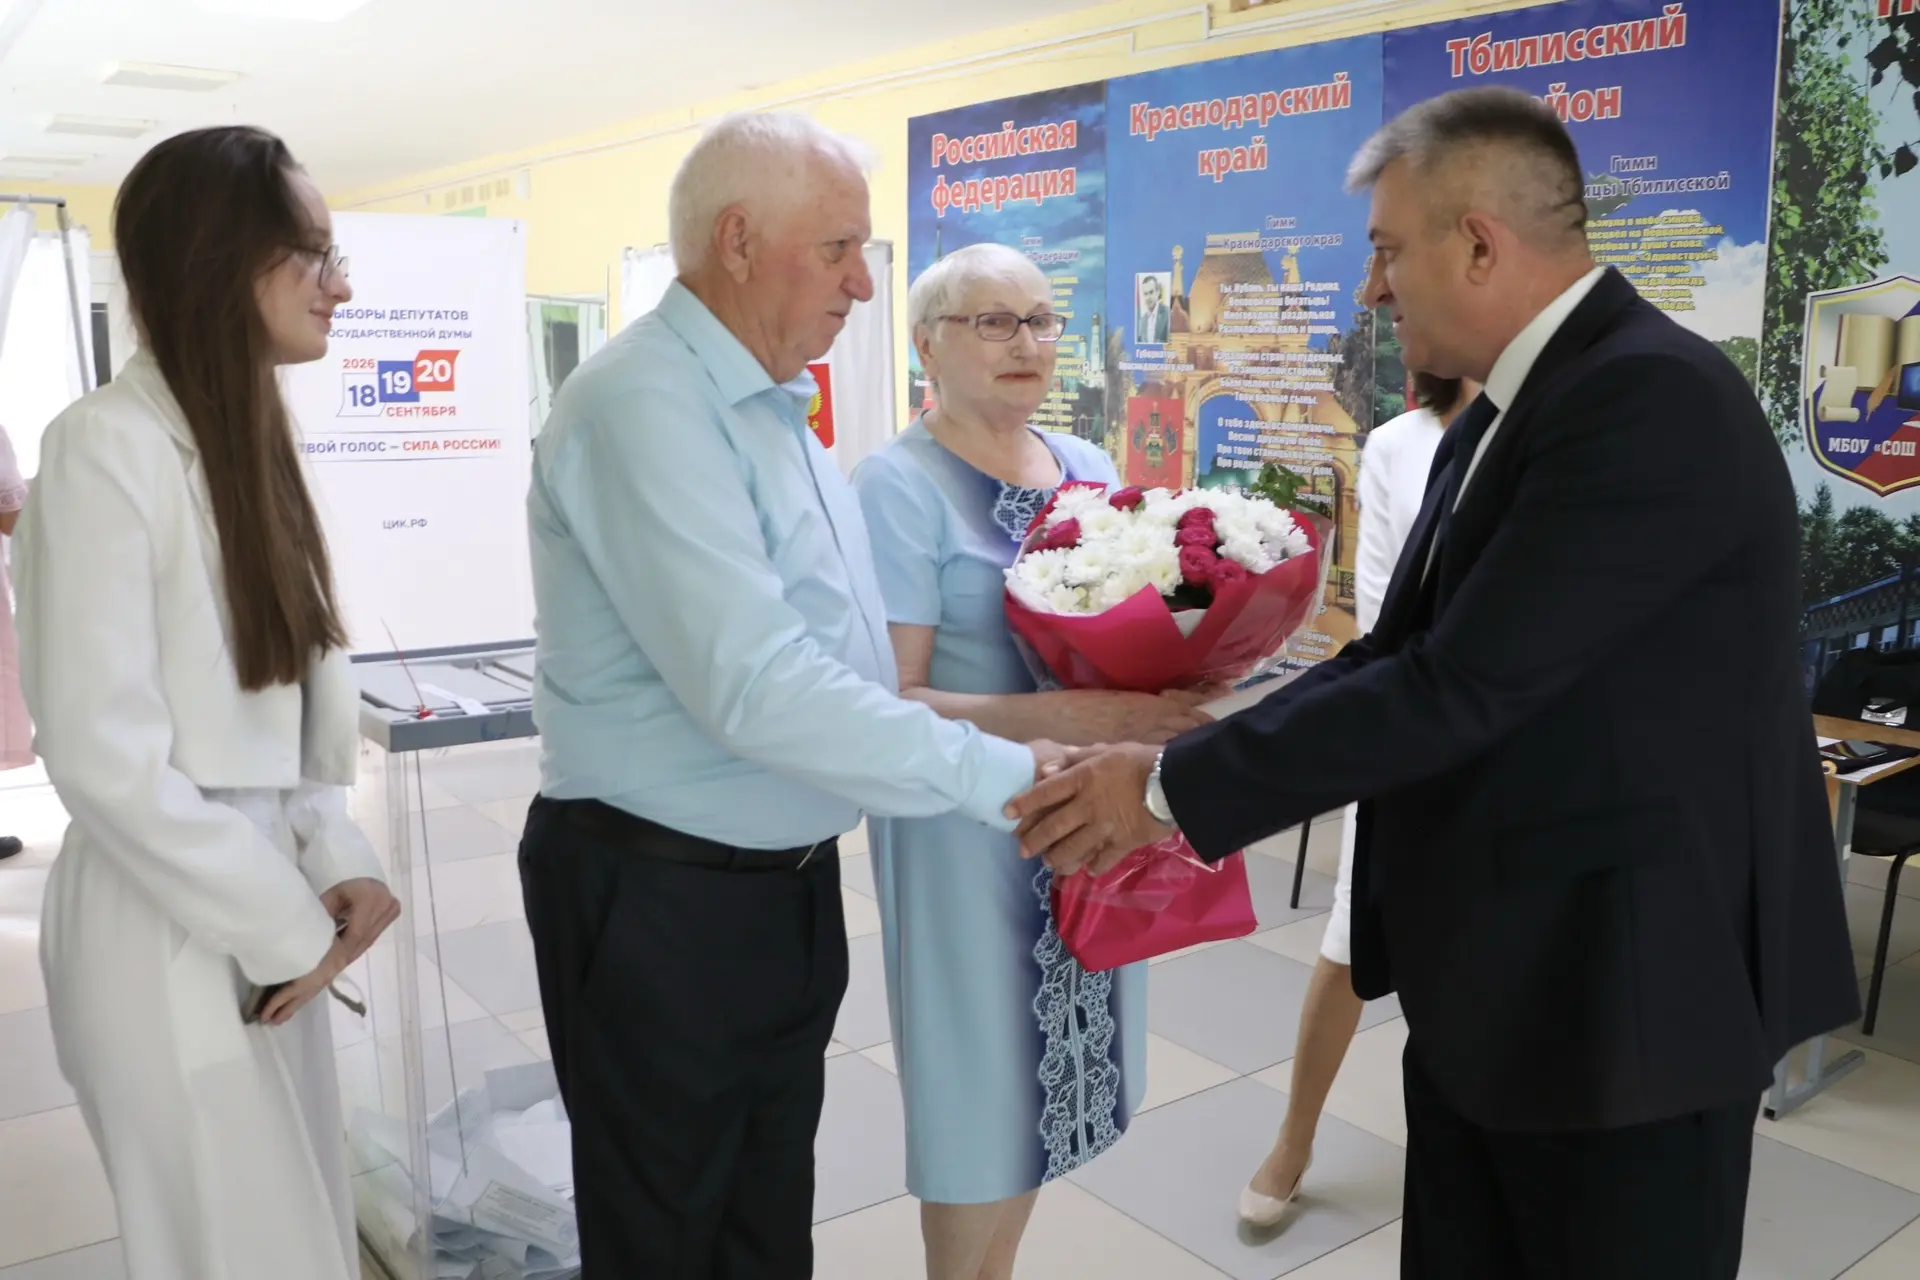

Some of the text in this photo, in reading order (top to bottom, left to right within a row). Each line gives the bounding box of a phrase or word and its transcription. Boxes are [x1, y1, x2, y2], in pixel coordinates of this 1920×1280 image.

[1446, 3, 1687, 78] Тбилисский
[1130, 72, 1351, 141] Краснодарский
[1546, 82, 1622, 123] йон
[932, 120, 1077, 168] Российская
[1198, 135, 1268, 183] край
[1611, 155, 1657, 173] Гимн
[931, 167, 1077, 218] федерация
[1620, 171, 1731, 197] Тбилисской
[1265, 215, 1297, 230] Гимн
[1222, 233, 1342, 252] Краснодарского края
[333, 308, 469, 321] ЫБОРЫ ДЕПУТАТОВ
[328, 327, 473, 340] ОСУДАРСТВЕННОЙ ДУМЫ
[342, 358, 375, 369] 2026
[348, 359, 452, 407] 18 19 20
[386, 406, 456, 418] СЕНТЯБРЯ
[340, 441, 387, 453] ГОЛОС
[402, 440, 439, 451] СИЛА
[443, 439, 501, 450] РОССИИ!
[1828, 437, 1918, 457] МБОУ «СОШ
[382, 519, 428, 530] ЦИК.РФ
